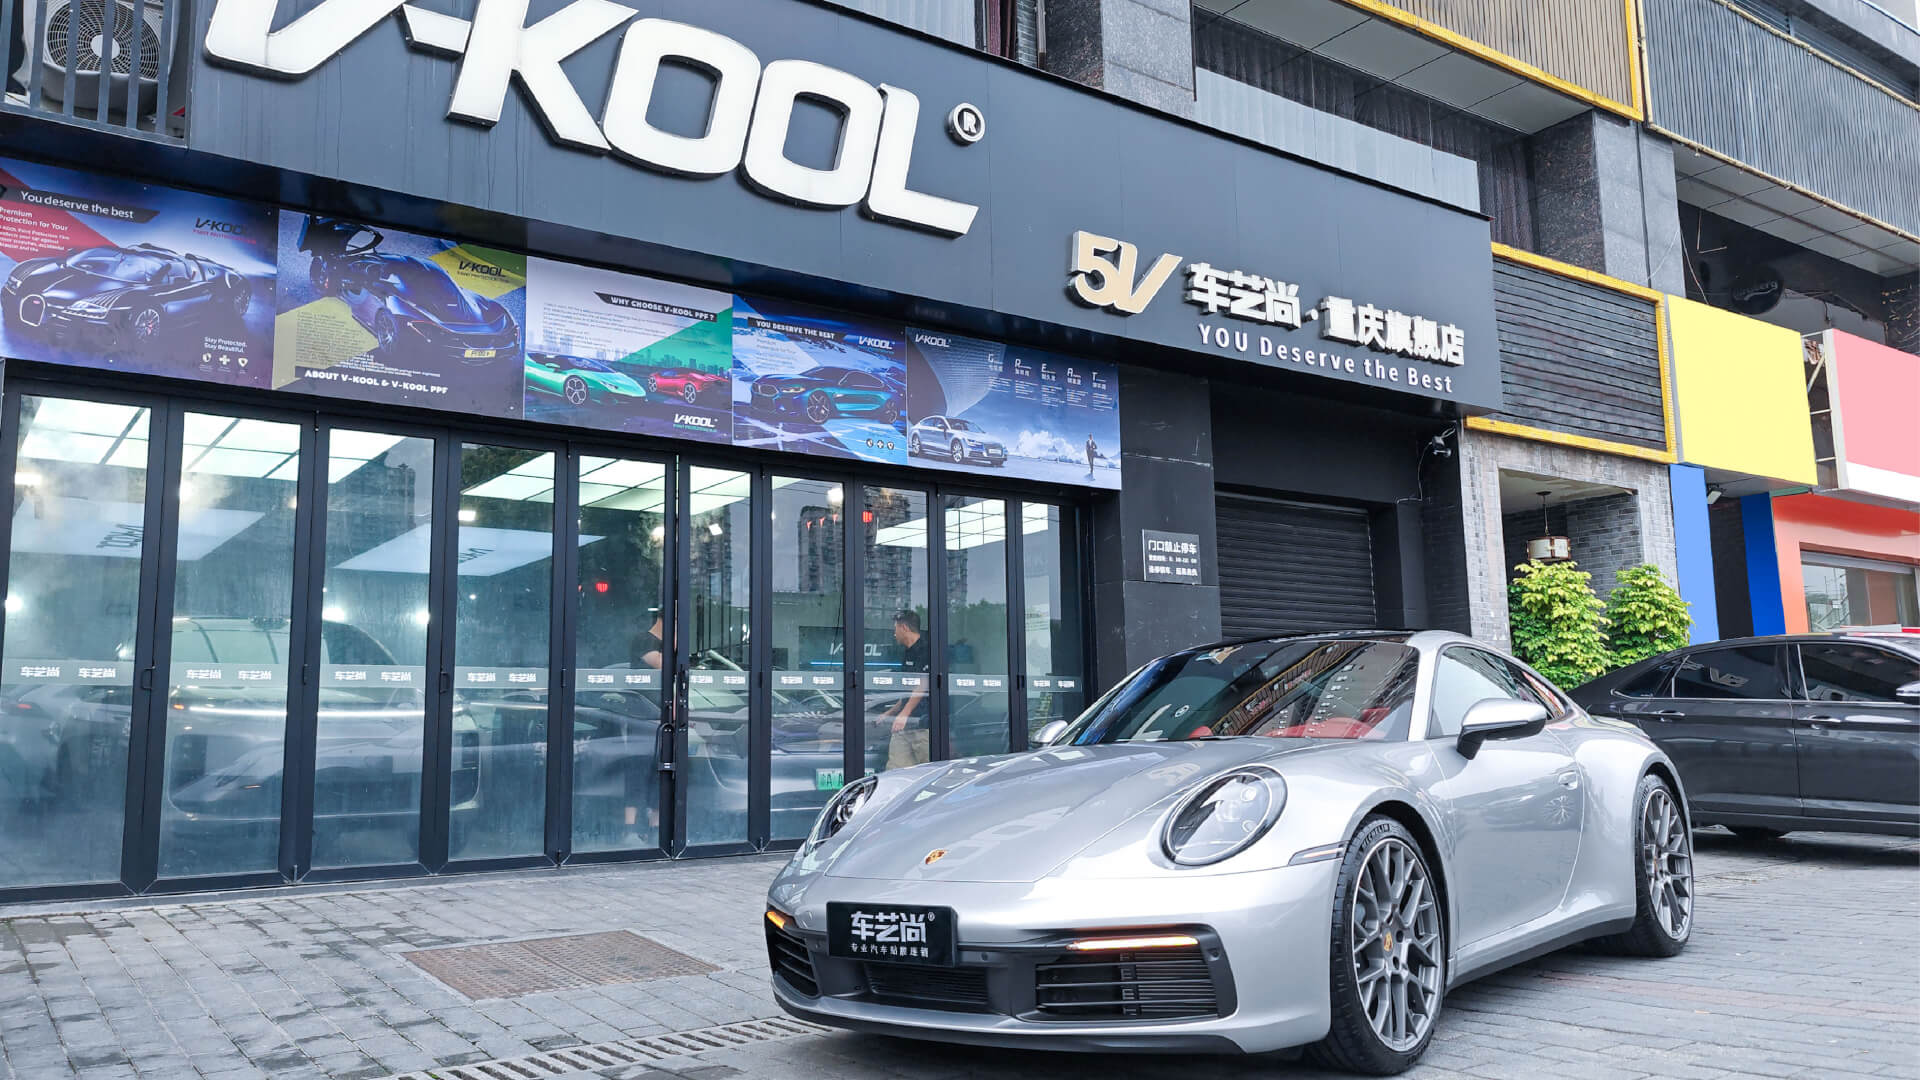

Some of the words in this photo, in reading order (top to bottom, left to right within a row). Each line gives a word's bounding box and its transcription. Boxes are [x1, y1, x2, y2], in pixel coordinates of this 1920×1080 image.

[0, 206, 33, 218] Premium
[20, 190, 43, 204] You
[44, 195, 89, 212] deserve
[91, 203, 110, 215] the
[111, 205, 135, 219] best
[39, 220, 50, 229] for
[50, 221, 69, 232] Your
[459, 260, 506, 278] V-KOOL
[611, 296, 630, 306] WHY
[631, 300, 663, 312] CHOOSE
[664, 305, 694, 317] V-KOOL
[694, 310, 710, 320] PPF
[756, 320, 771, 329] YOU
[772, 322, 803, 335] DESERVE
[804, 327, 818, 337] THE
[819, 330, 835, 339] BEST
[858, 336, 893, 350] V-KOOL
[915, 334, 950, 348] V-KOOL
[1198, 323, 1249, 353] YOU
[1259, 335, 1355, 374] Deserve
[1363, 357, 1399, 382] the
[1407, 366, 1453, 394] Best
[304, 369, 339, 381] ABOUT
[341, 373, 380, 387] V-KOOL
[381, 378, 391, 387] &
[391, 380, 429, 393] V-KOOL
[430, 385, 449, 395] PPF
[673, 413, 716, 428] V-KOOL
[20, 666, 60, 678] 车艺尚
[78, 668, 116, 679] 车艺尚
[186, 669, 222, 680] 车艺尚
[850, 911, 927, 944] 车艺尚
